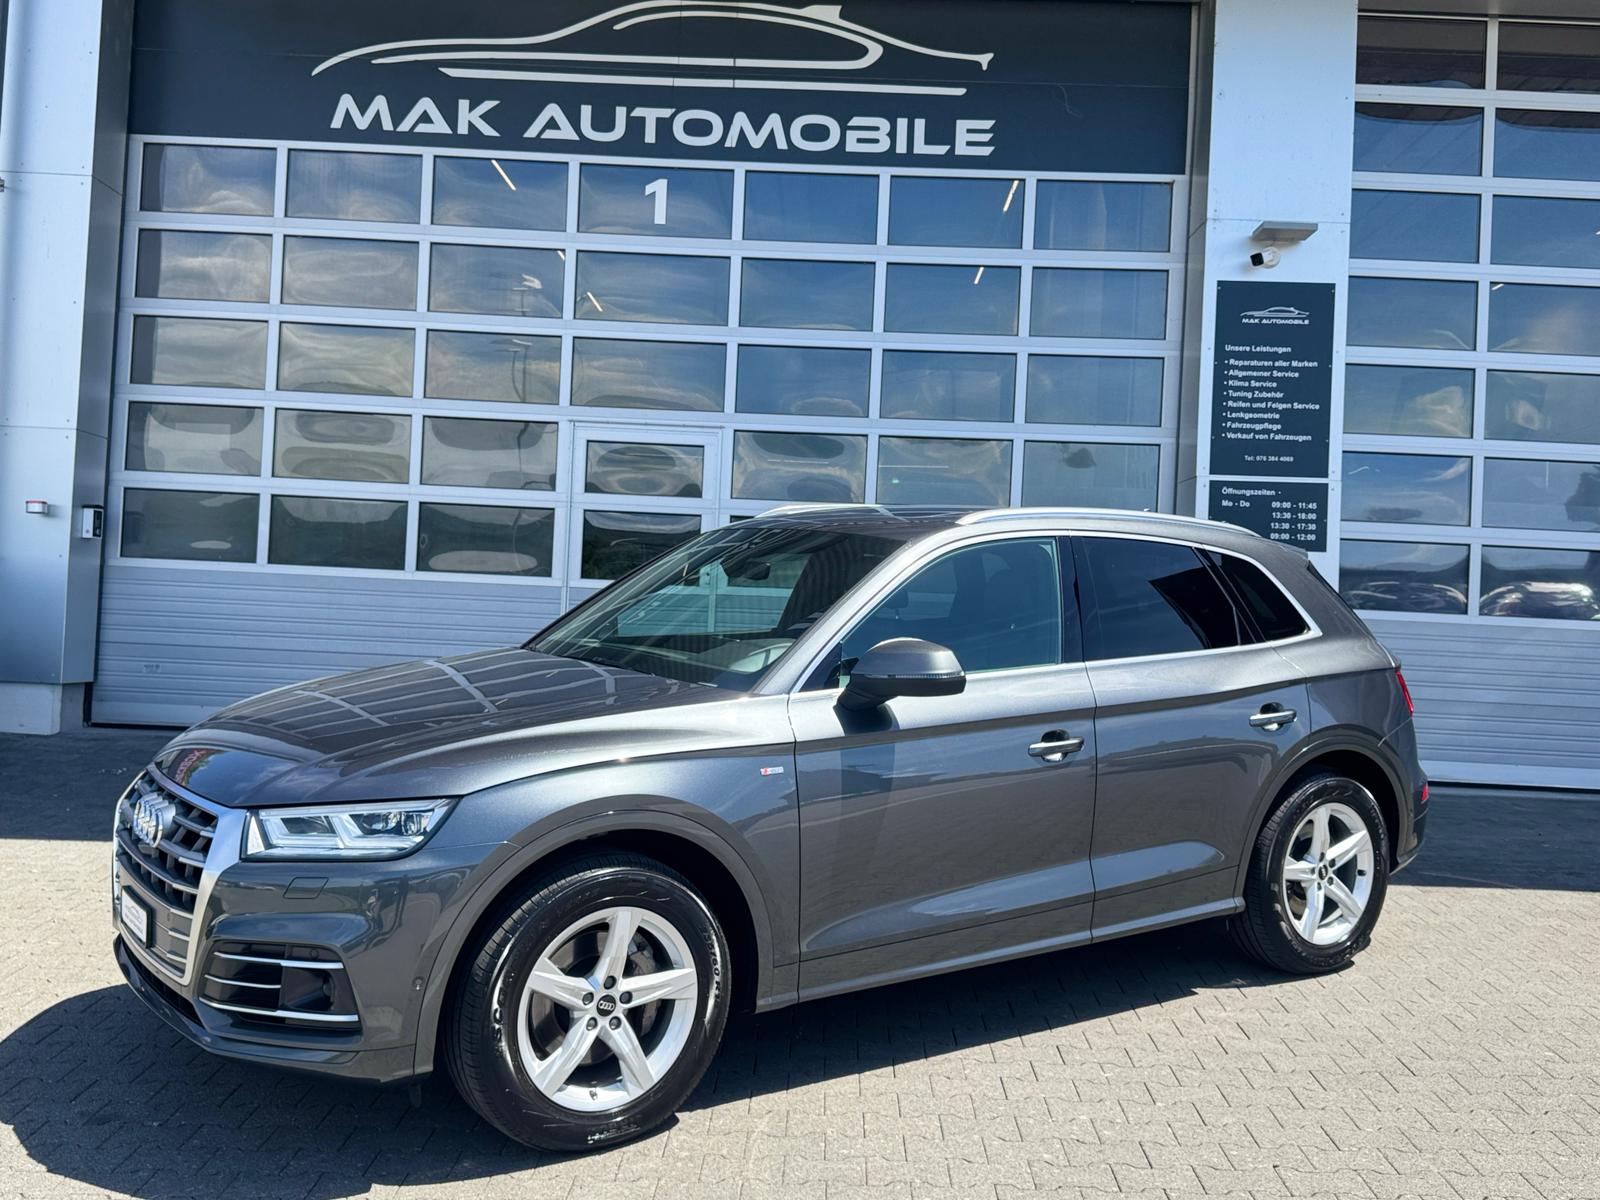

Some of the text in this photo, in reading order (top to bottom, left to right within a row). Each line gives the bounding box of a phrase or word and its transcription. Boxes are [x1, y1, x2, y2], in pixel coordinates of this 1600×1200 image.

[330, 93, 997, 156] MAK AUTOMOBILE
[644, 178, 668, 225] 1
[1225, 344, 1292, 354] Unsere Leistungen
[1229, 359, 1273, 368] Reparaturen
[1291, 360, 1318, 368] Marken
[1228, 369, 1299, 378] Allgemeiner Service
[1250, 380, 1277, 388] Service
[1228, 390, 1284, 399] Tuning Zubehör
[1227, 400, 1251, 408] Reifen
[1267, 401, 1292, 410] Felgen
[1293, 402, 1320, 410] Service
[1227, 411, 1280, 420] Lenkgeometrie
[1226, 421, 1282, 431] Fahrzeugpflege
[1226, 432, 1254, 440] Verkauf
[1270, 433, 1312, 442] Fahrzeugen
[1221, 487, 1275, 496] Öffnungszeiten
[1271, 501, 1292, 509] 09:00
[1298, 502, 1317, 510] 11:45
[1297, 512, 1317, 520] 18:00
[1270, 522, 1290, 530] 13:30
[1297, 523, 1317, 531] 17:30
[1270, 532, 1290, 540] 09:00
[1297, 533, 1316, 541] 12:00
